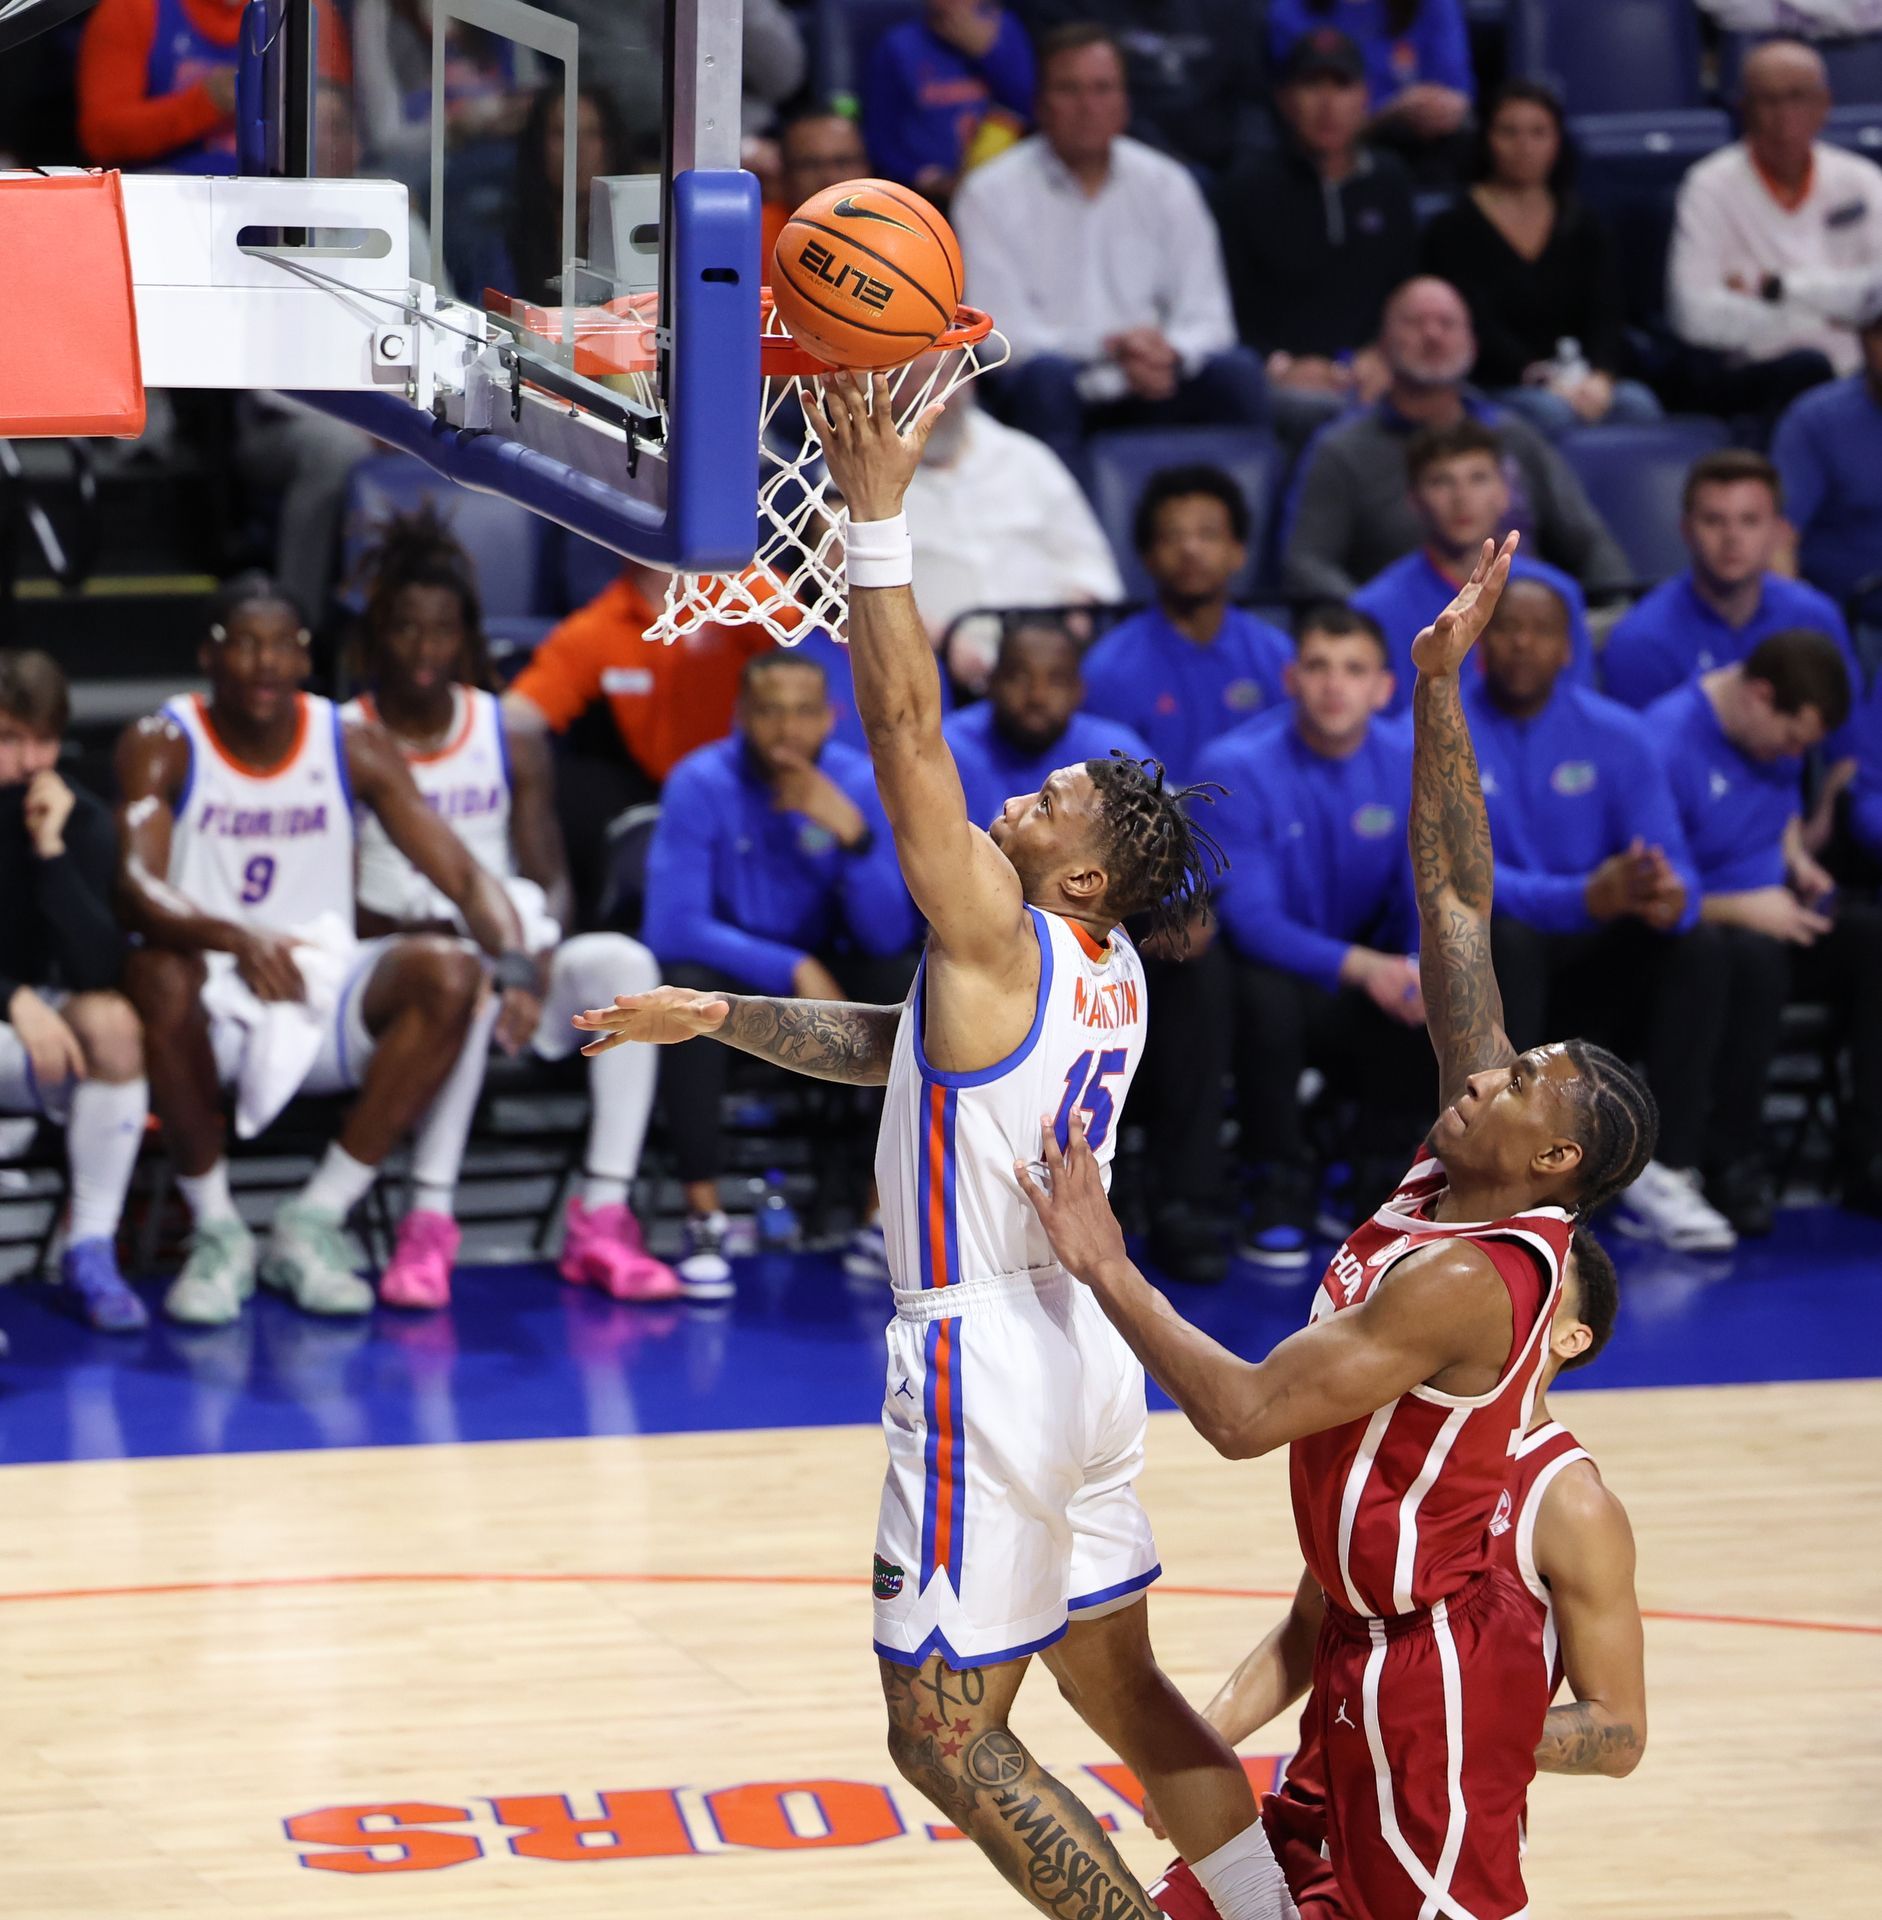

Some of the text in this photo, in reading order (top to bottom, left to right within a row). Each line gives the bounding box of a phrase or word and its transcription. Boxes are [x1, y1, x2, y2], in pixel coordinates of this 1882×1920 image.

[798, 239, 895, 311] ELITE
[198, 803, 329, 839] FLORIDA
[240, 855, 276, 904] 9
[1072, 975, 1138, 1030] MARTIN
[1046, 1047, 1129, 1160] 15
[918, 1658, 985, 1727] XO
